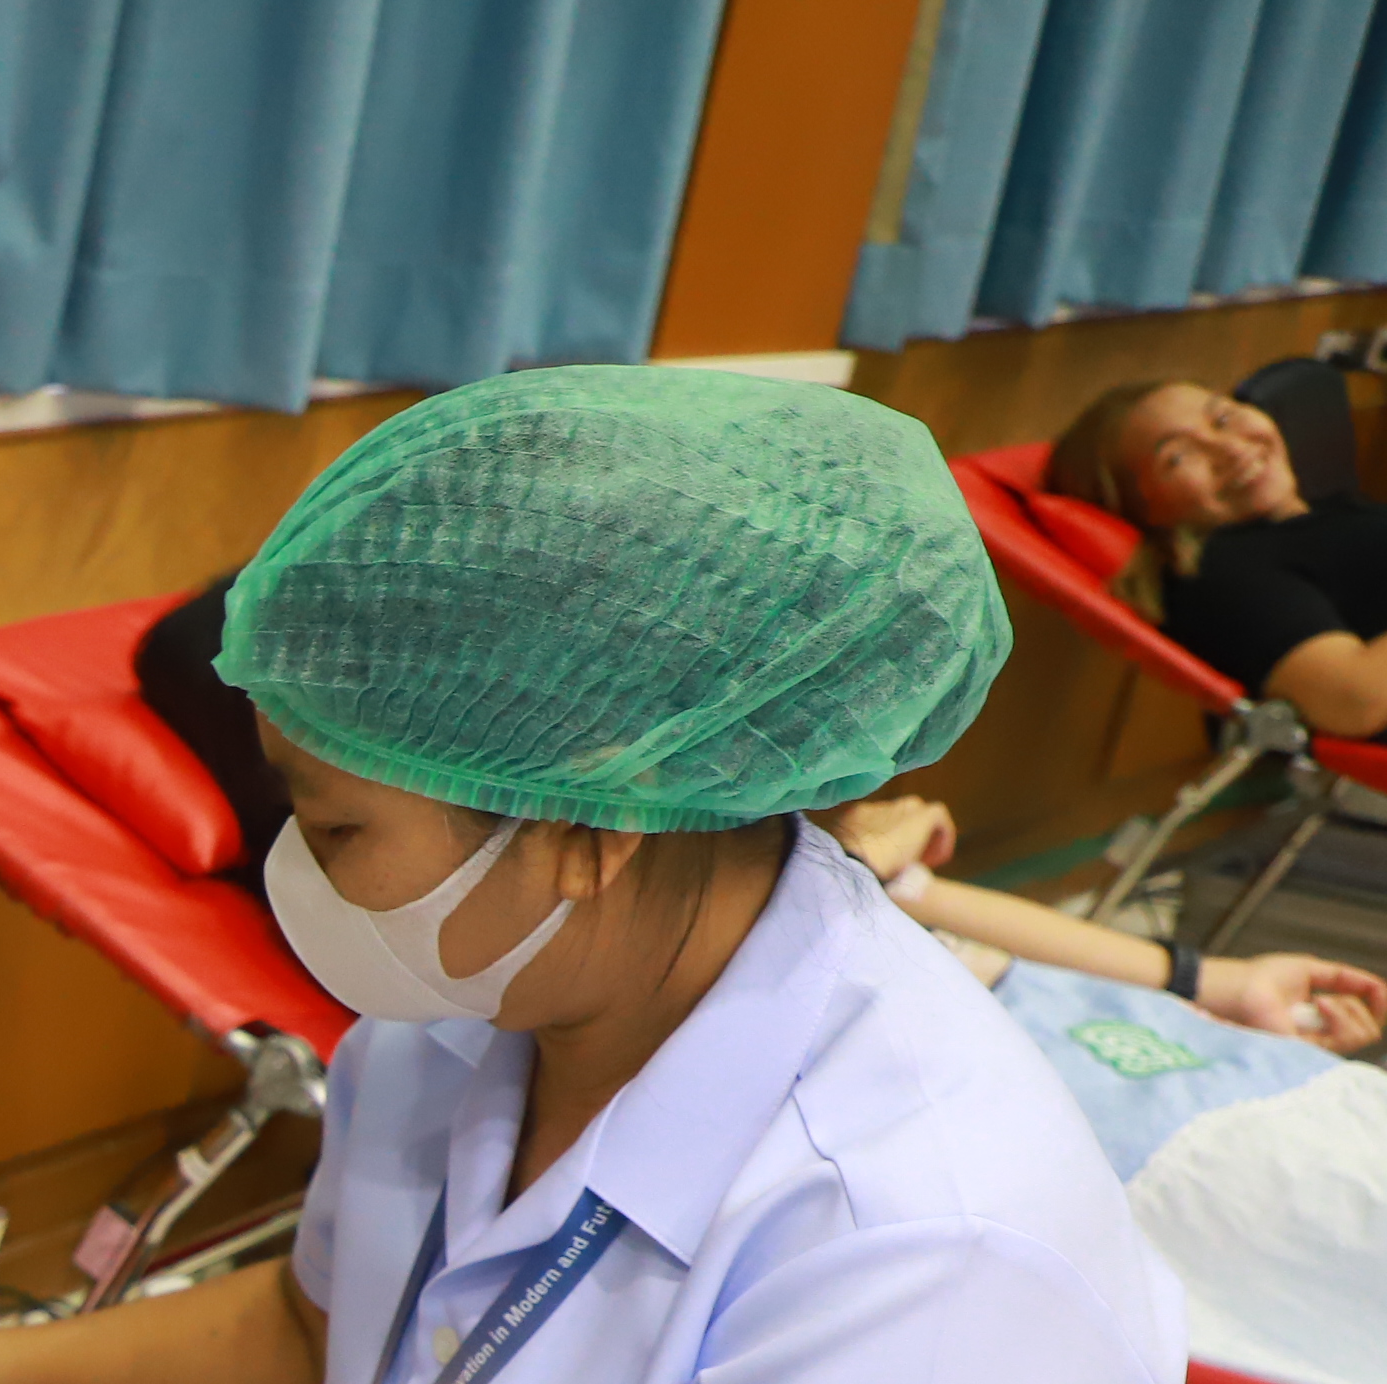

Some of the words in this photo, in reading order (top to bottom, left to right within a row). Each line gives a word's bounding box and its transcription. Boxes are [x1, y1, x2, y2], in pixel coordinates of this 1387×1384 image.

[487, 1321, 511, 1345] in
[501, 1261, 563, 1329] Modern
[553, 1231, 590, 1271] and
